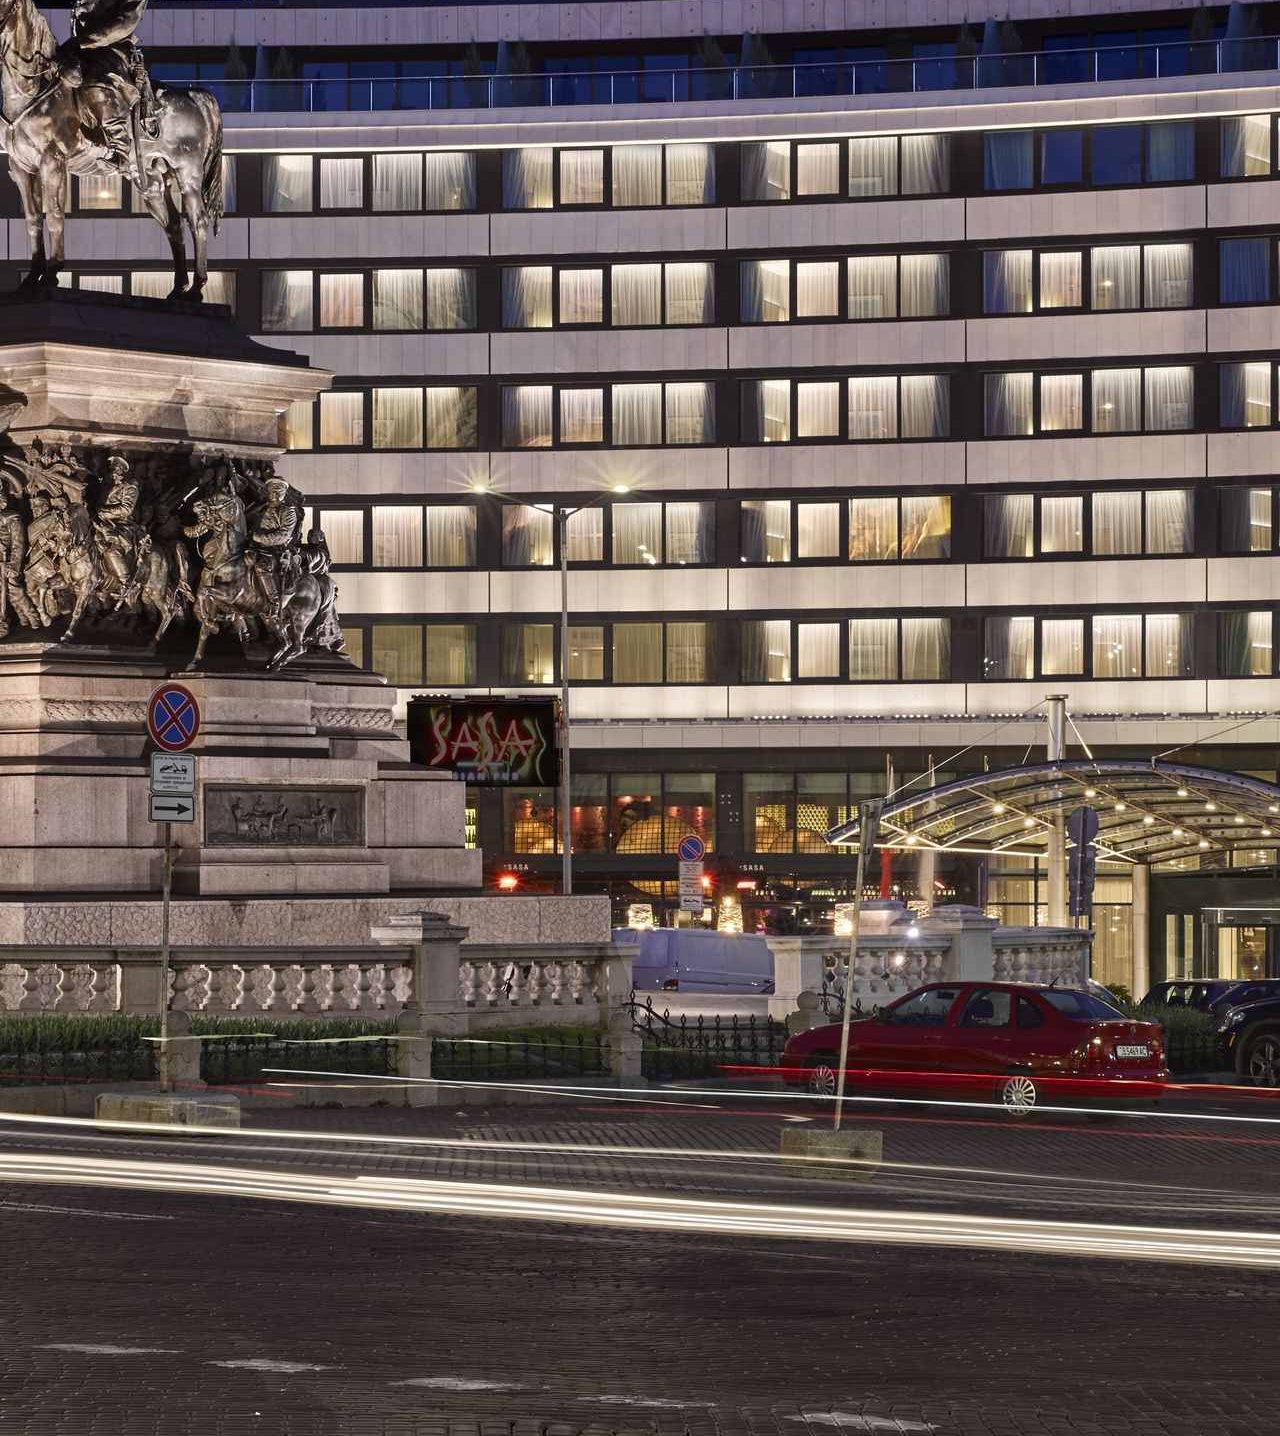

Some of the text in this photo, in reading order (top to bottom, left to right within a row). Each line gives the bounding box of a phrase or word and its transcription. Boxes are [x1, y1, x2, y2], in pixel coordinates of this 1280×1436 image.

[430, 711, 535, 772] SASA
[451, 772, 486, 781] SIAN
[507, 863, 529, 871] SASA
